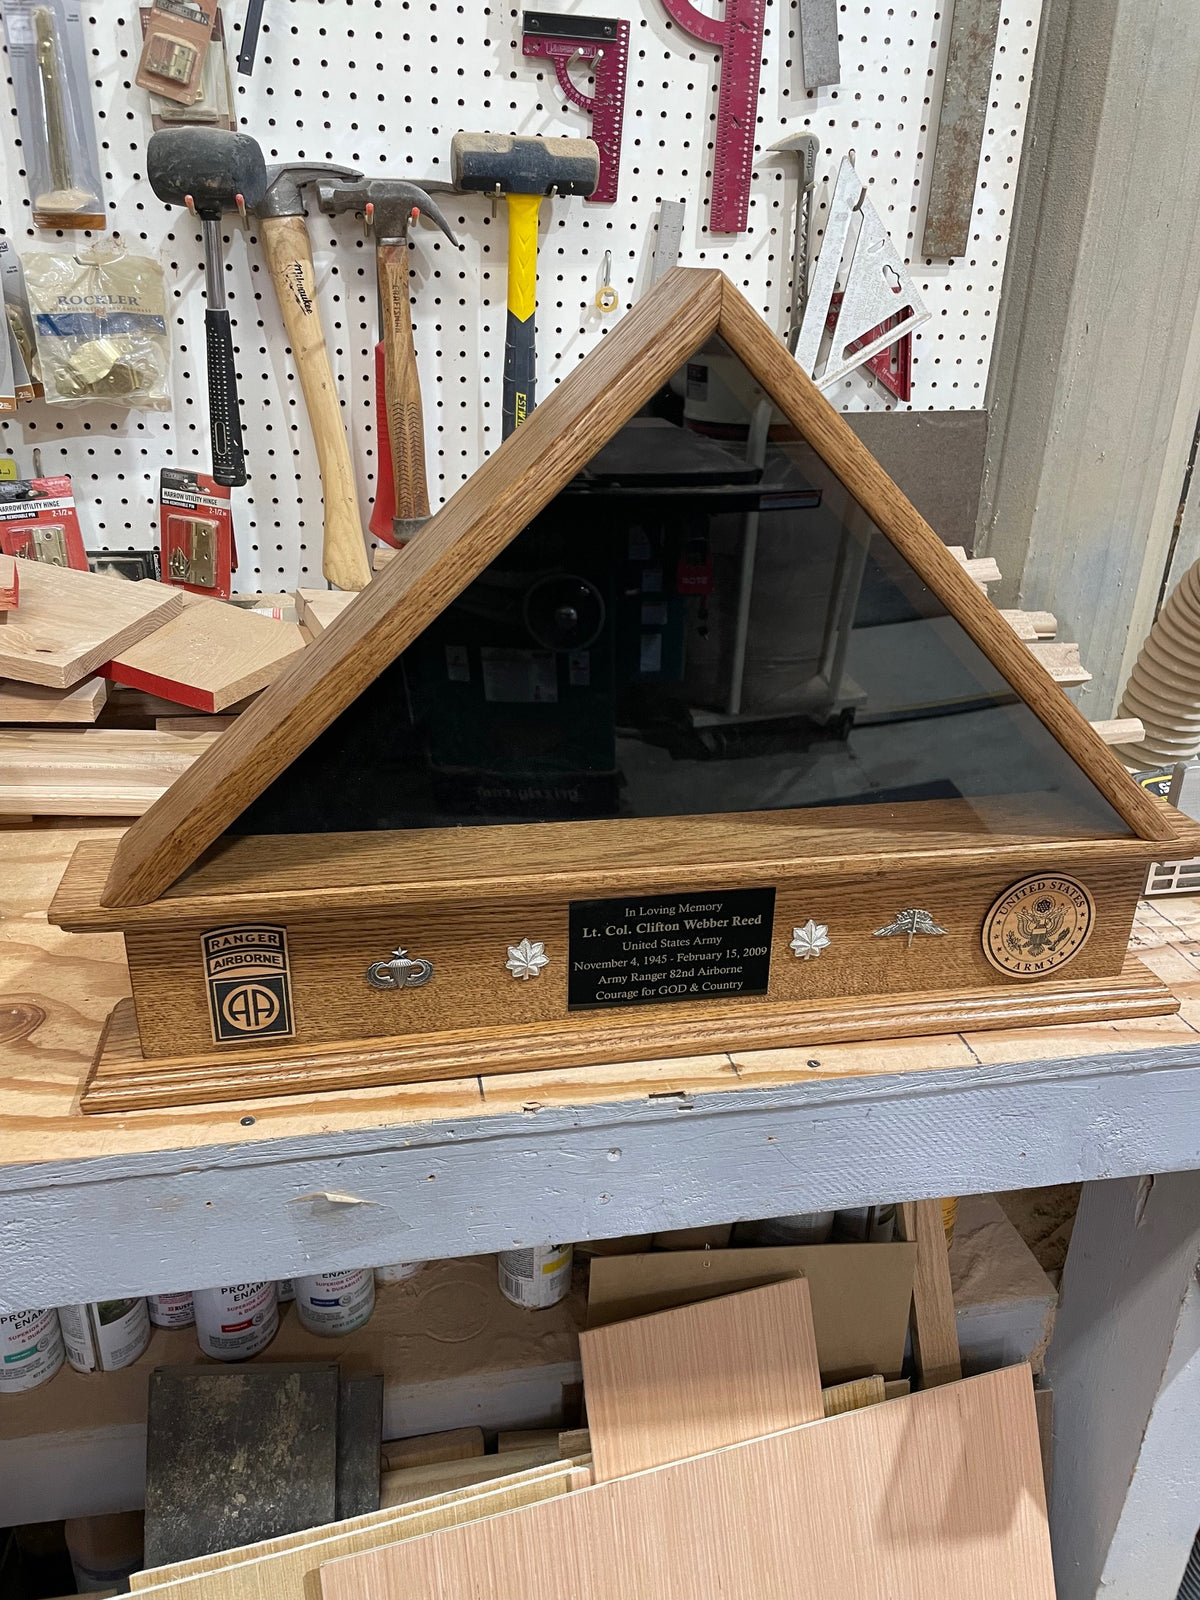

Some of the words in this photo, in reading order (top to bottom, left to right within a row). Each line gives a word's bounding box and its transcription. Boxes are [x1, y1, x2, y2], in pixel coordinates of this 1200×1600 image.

[57, 295, 140, 306] ROCKLER
[392, 284, 402, 334] CRAFTSMAN
[23, 502, 43, 511] UTILITY
[43, 500, 60, 508] HINGE
[163, 490, 184, 500] NARROW
[184, 494, 202, 503] UTILITY
[202, 498, 217, 506] HINGE
[52, 509, 67, 517] 2-1/2
[209, 506, 222, 516] 2-1/2
[1000, 881, 1046, 916] UNITED
[1049, 881, 1086, 908] STATES
[625, 907, 636, 918] In
[639, 904, 676, 917] Loving
[678, 903, 723, 916] Memory
[582, 927, 602, 939] Lt.
[605, 924, 632, 937] Col.
[636, 922, 680, 935] Clifton
[684, 917, 729, 930] Webber
[732, 914, 762, 927] Reed
[211, 934, 279, 950] RANGER
[622, 938, 658, 951] United
[660, 938, 690, 949] States
[693, 936, 722, 949] Army
[213, 954, 281, 970] AIRBORNE
[573, 959, 628, 972] November
[630, 957, 640, 968] 4,
[644, 954, 668, 966] 1945
[677, 951, 722, 964] February
[726, 949, 740, 960] 15,
[743, 946, 768, 958] 2009
[1013, 957, 1055, 972] ARMY
[598, 974, 628, 987] Army
[631, 971, 668, 985] Ranger
[669, 967, 695, 979] 82nd
[697, 965, 743, 978] Airborne
[595, 989, 639, 1002] Courage
[641, 986, 656, 997] for
[658, 984, 687, 995] GOD
[690, 983, 699, 992] &
[701, 980, 743, 993] Country
[315, 1279, 344, 1287] SUPERIOR
[227, 1299, 256, 1312] SUPERIOR
